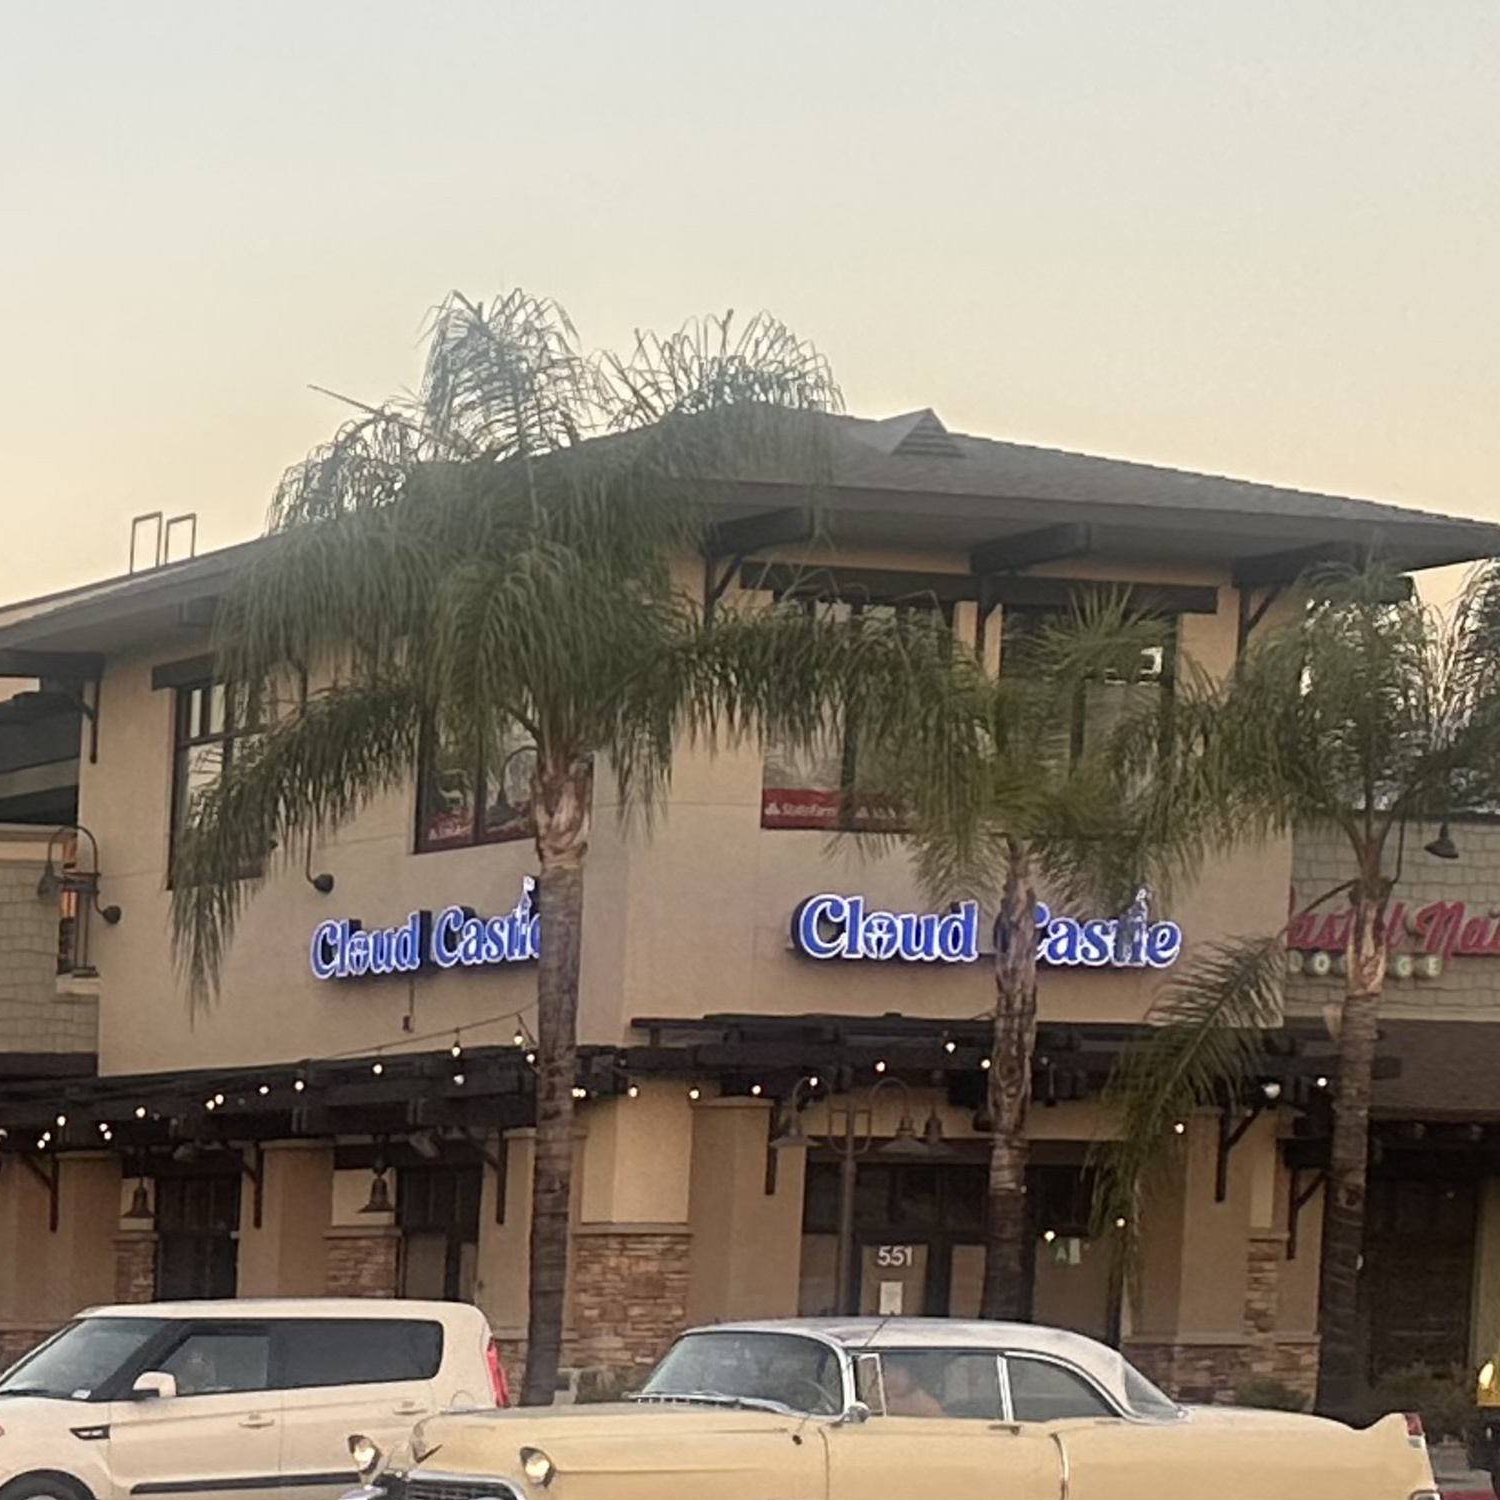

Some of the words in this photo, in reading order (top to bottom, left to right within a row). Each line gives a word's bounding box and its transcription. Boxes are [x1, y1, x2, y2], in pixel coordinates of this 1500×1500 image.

[311, 911, 420, 979] Cloud
[800, 894, 980, 962] Cloud
[877, 1246, 912, 1267] 551
